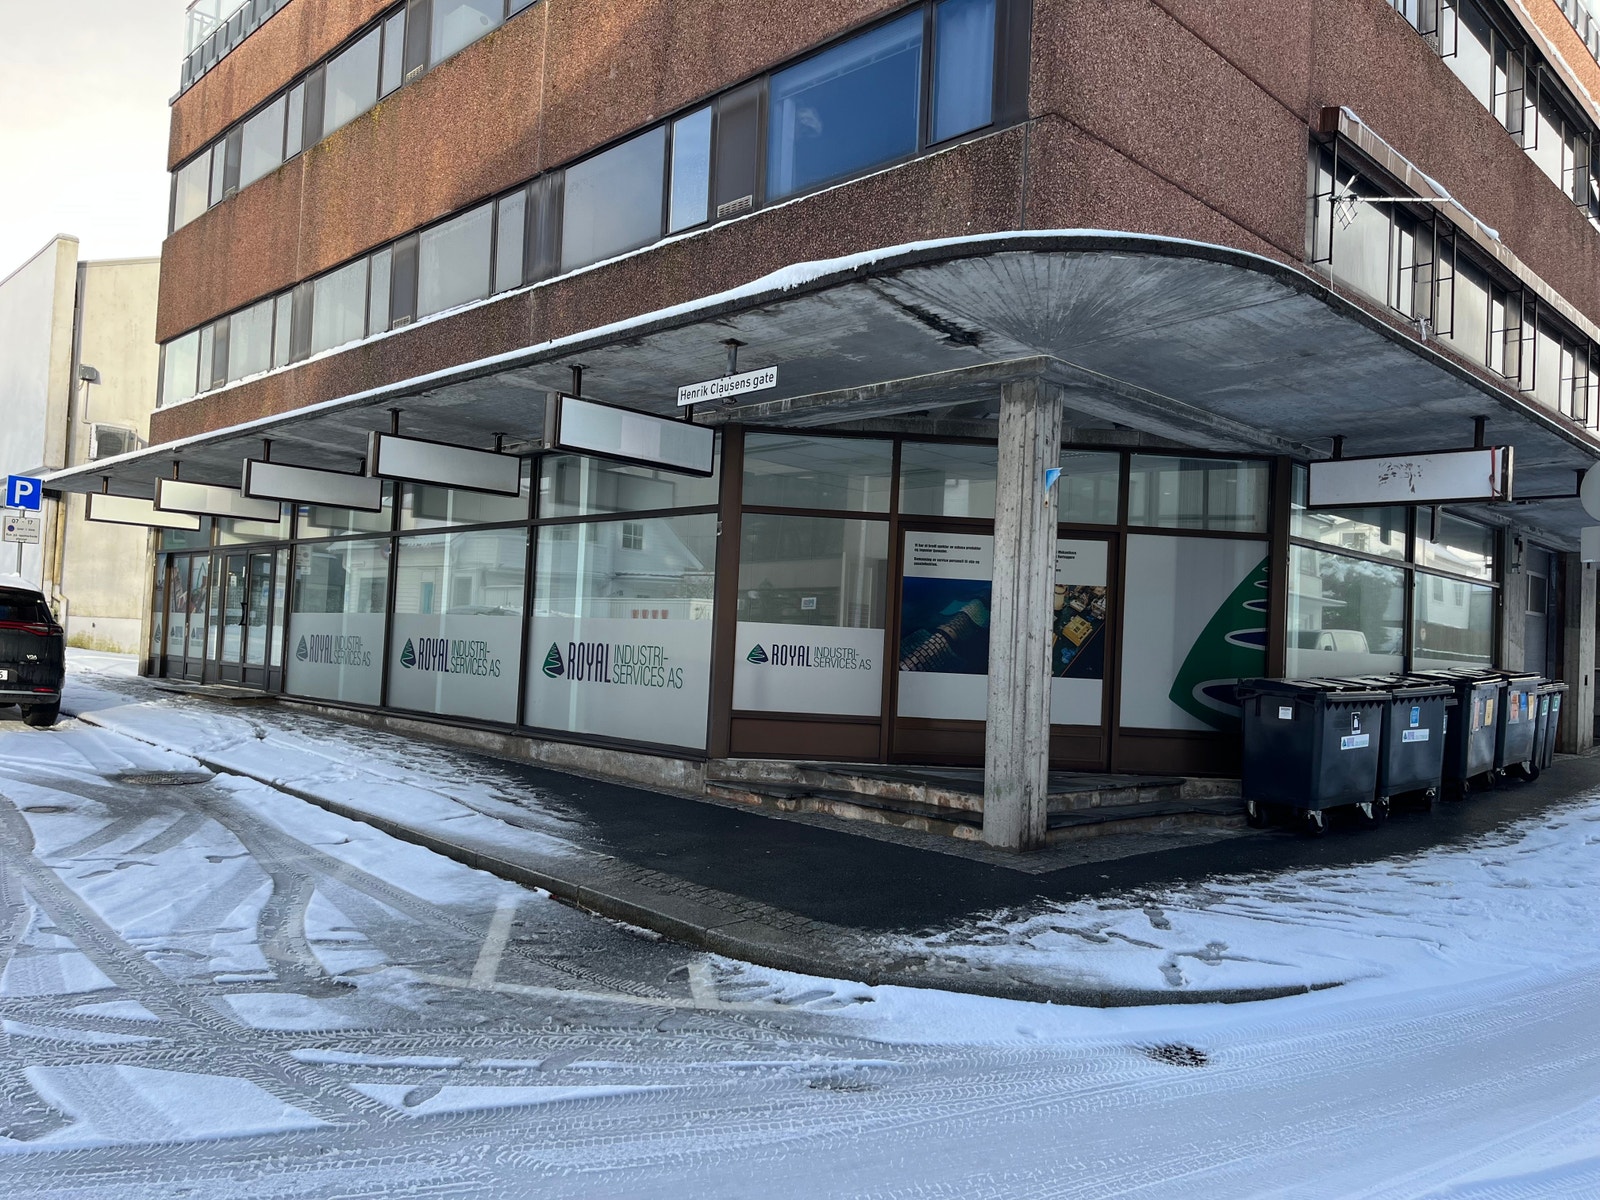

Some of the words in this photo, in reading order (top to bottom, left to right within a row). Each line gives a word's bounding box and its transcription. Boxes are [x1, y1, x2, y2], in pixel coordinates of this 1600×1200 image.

[680, 386, 708, 401] Henrik
[710, 377, 751, 395] Clausens
[753, 372, 774, 389] gate
[14, 480, 33, 504] P
[308, 634, 333, 664] ROYAL
[333, 649, 360, 666] SERVICES
[361, 651, 371, 667] AS
[418, 638, 449, 672] ROYAL
[771, 644, 812, 667] ROYAL
[450, 656, 487, 676] SERVICES
[489, 659, 501, 678] AS
[567, 642, 611, 683] ROYAL
[813, 656, 857, 670] SERVICES
[859, 658, 872, 671] AS
[612, 664, 664, 688] SERVICES
[667, 667, 684, 690] AS
